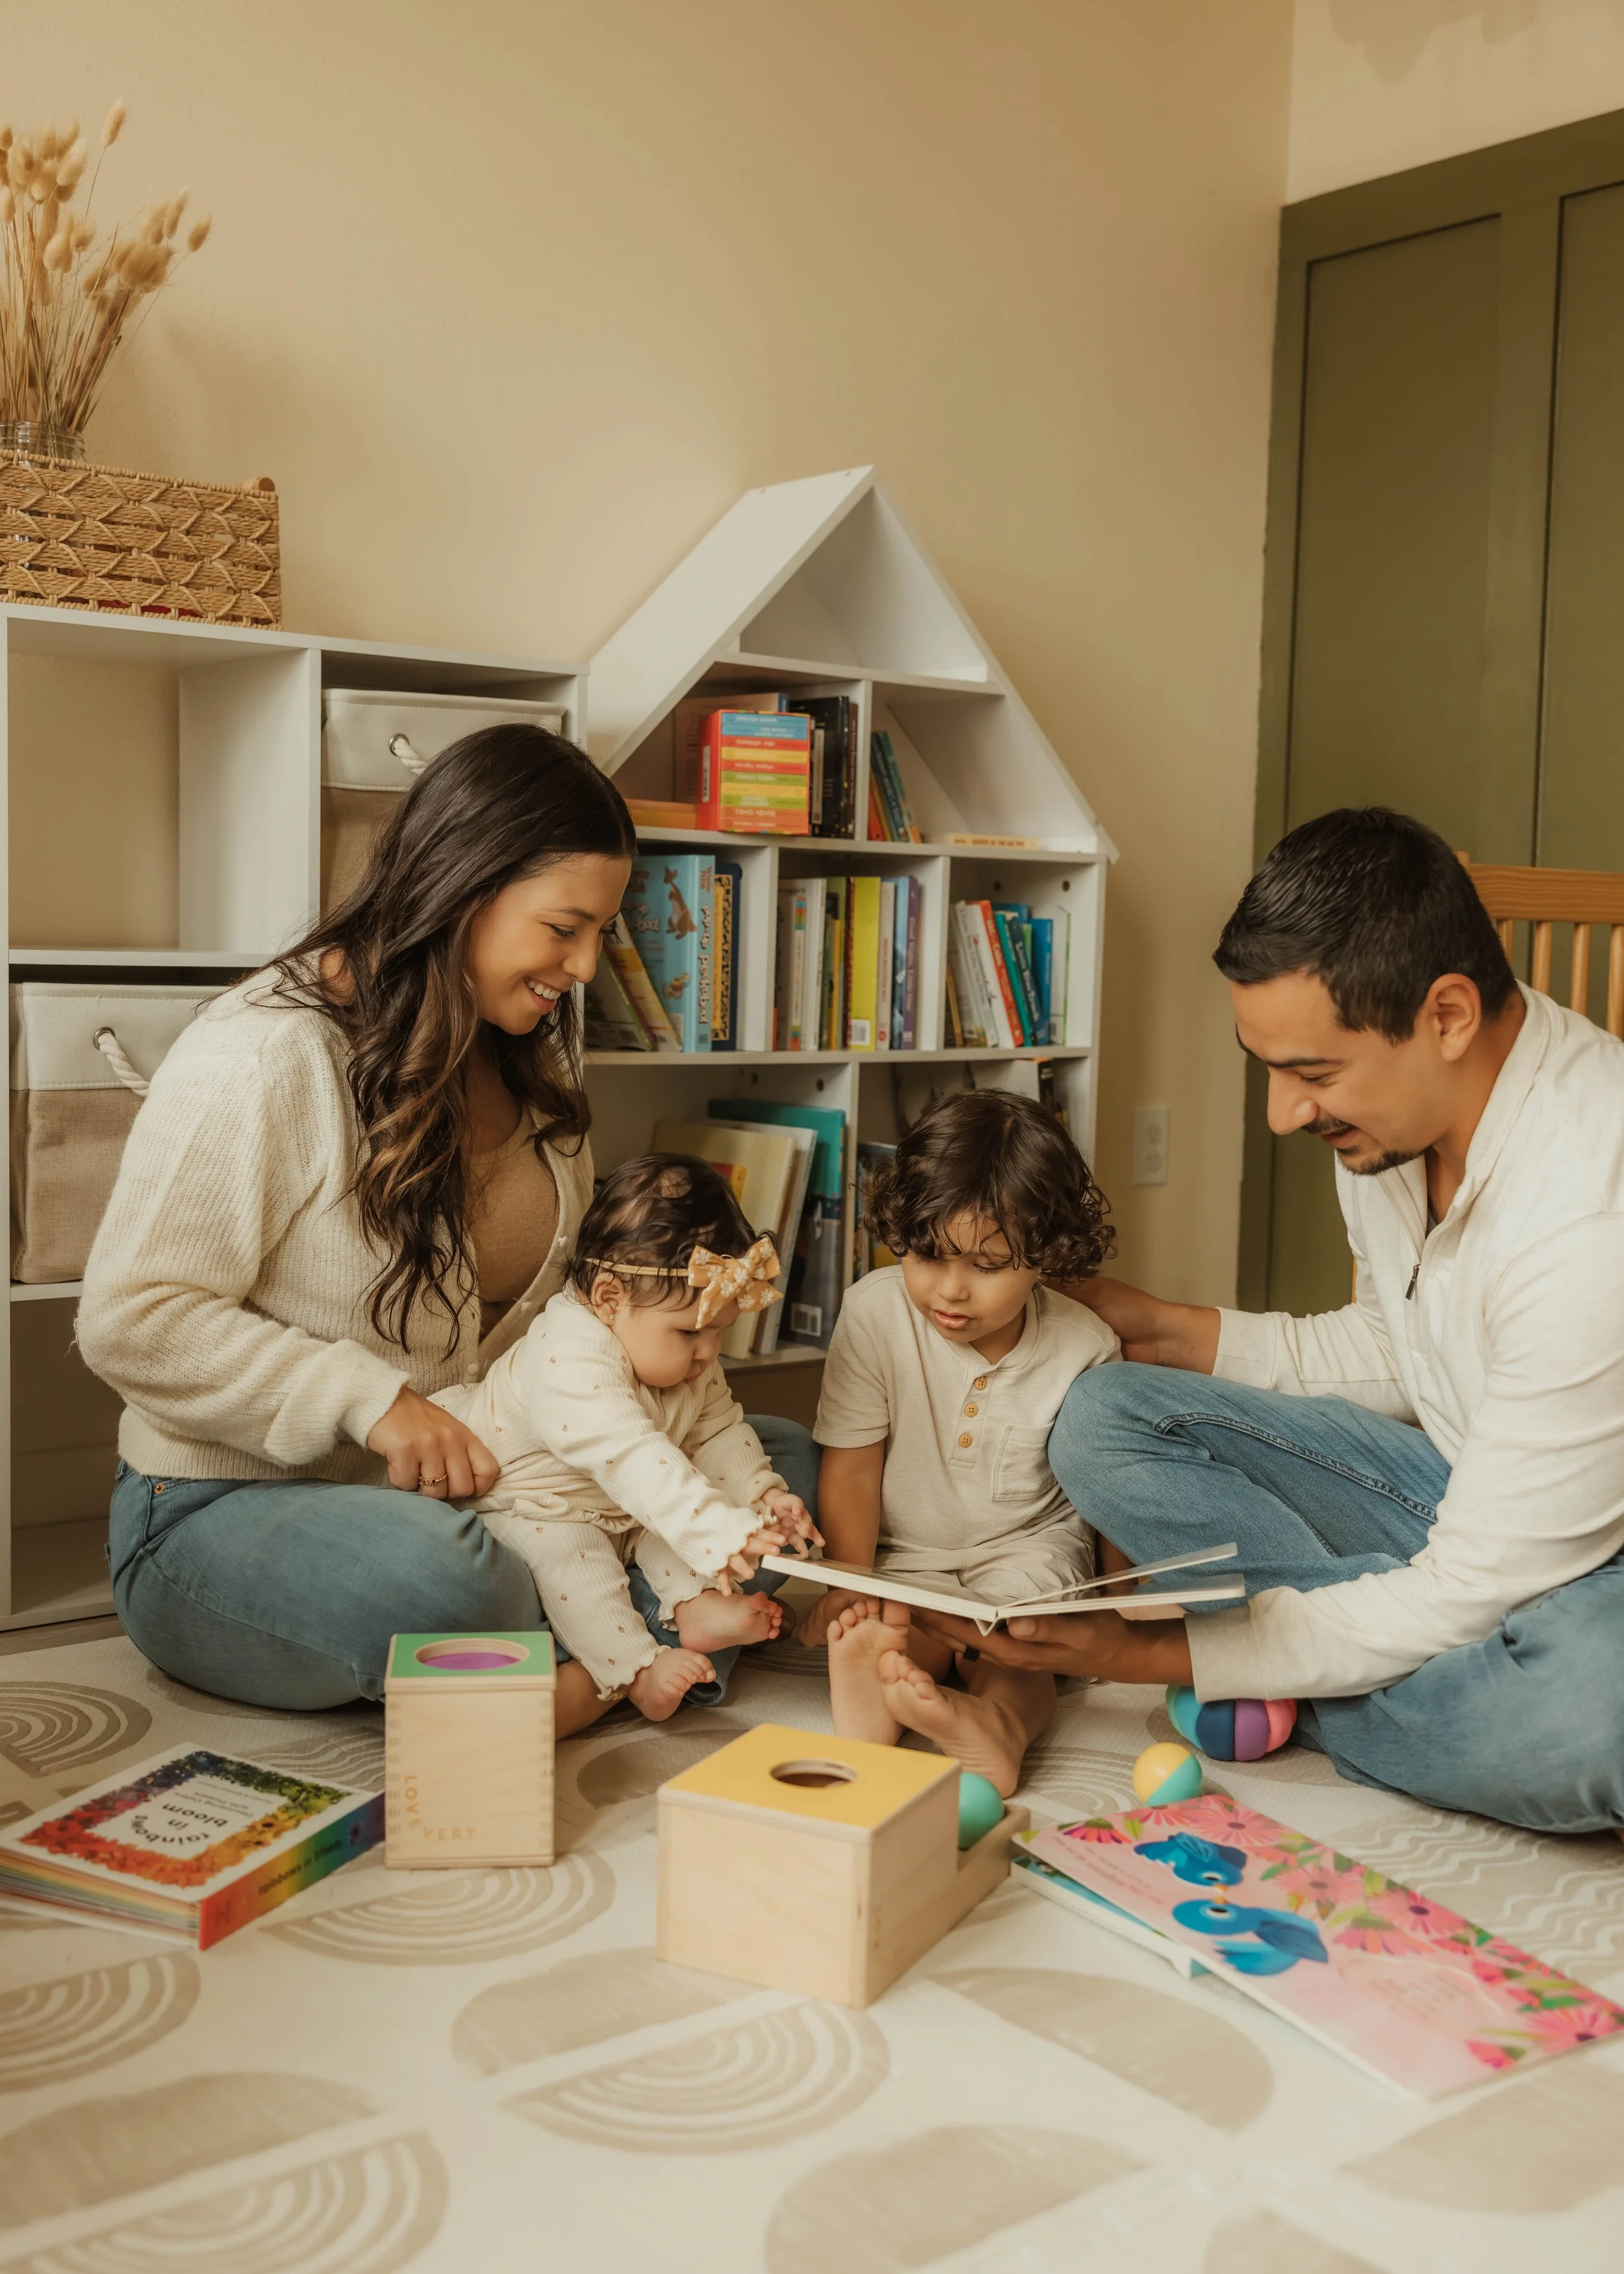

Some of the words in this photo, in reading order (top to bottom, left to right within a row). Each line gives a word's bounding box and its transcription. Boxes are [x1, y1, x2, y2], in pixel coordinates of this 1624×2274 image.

[907, 917, 916, 939] Good
[1015, 941, 1029, 973] Little
[1021, 969, 1034, 992] Blue
[1027, 989, 1041, 1022] Truck
[162, 1803, 229, 1828] bloom
[403, 1774, 421, 1830] LOVE
[422, 1826, 476, 1841] VERY
[130, 1813, 210, 1847] rainbows
[167, 1819, 190, 1832] in
[257, 1862, 302, 1897] rainbows
[304, 1856, 313, 1869] in
[314, 1839, 342, 1860] bloom
